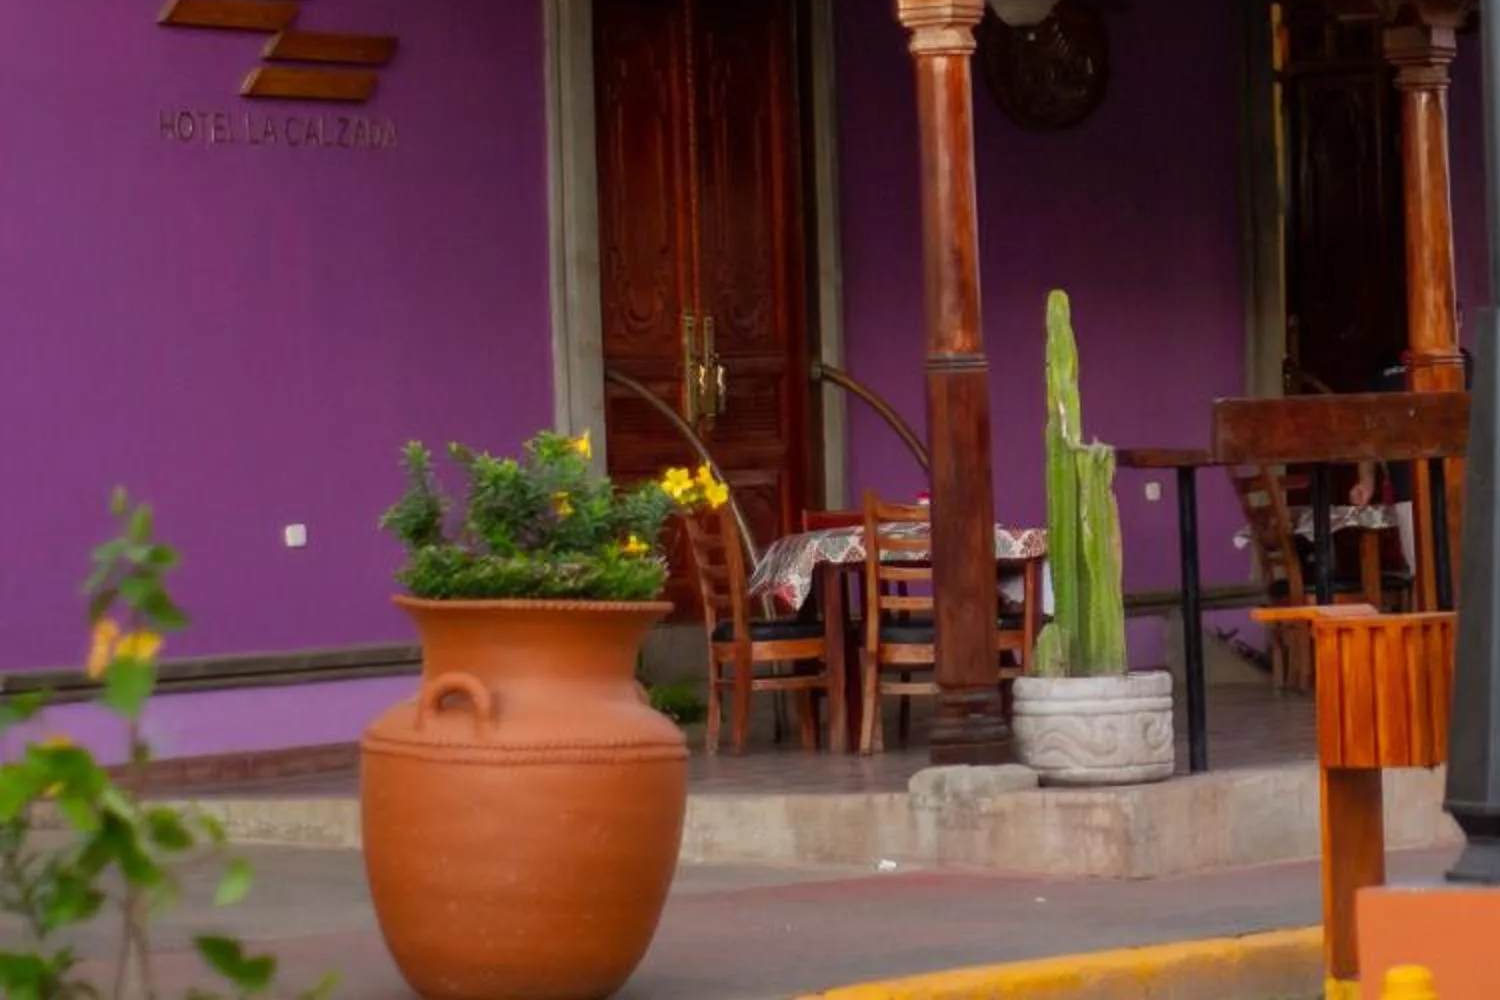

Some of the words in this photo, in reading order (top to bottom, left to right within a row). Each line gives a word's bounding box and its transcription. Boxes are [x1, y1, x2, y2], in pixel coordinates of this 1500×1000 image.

[159, 110, 239, 143] HOTEL
[247, 113, 278, 146] LA
[284, 115, 399, 149] CALZADA
